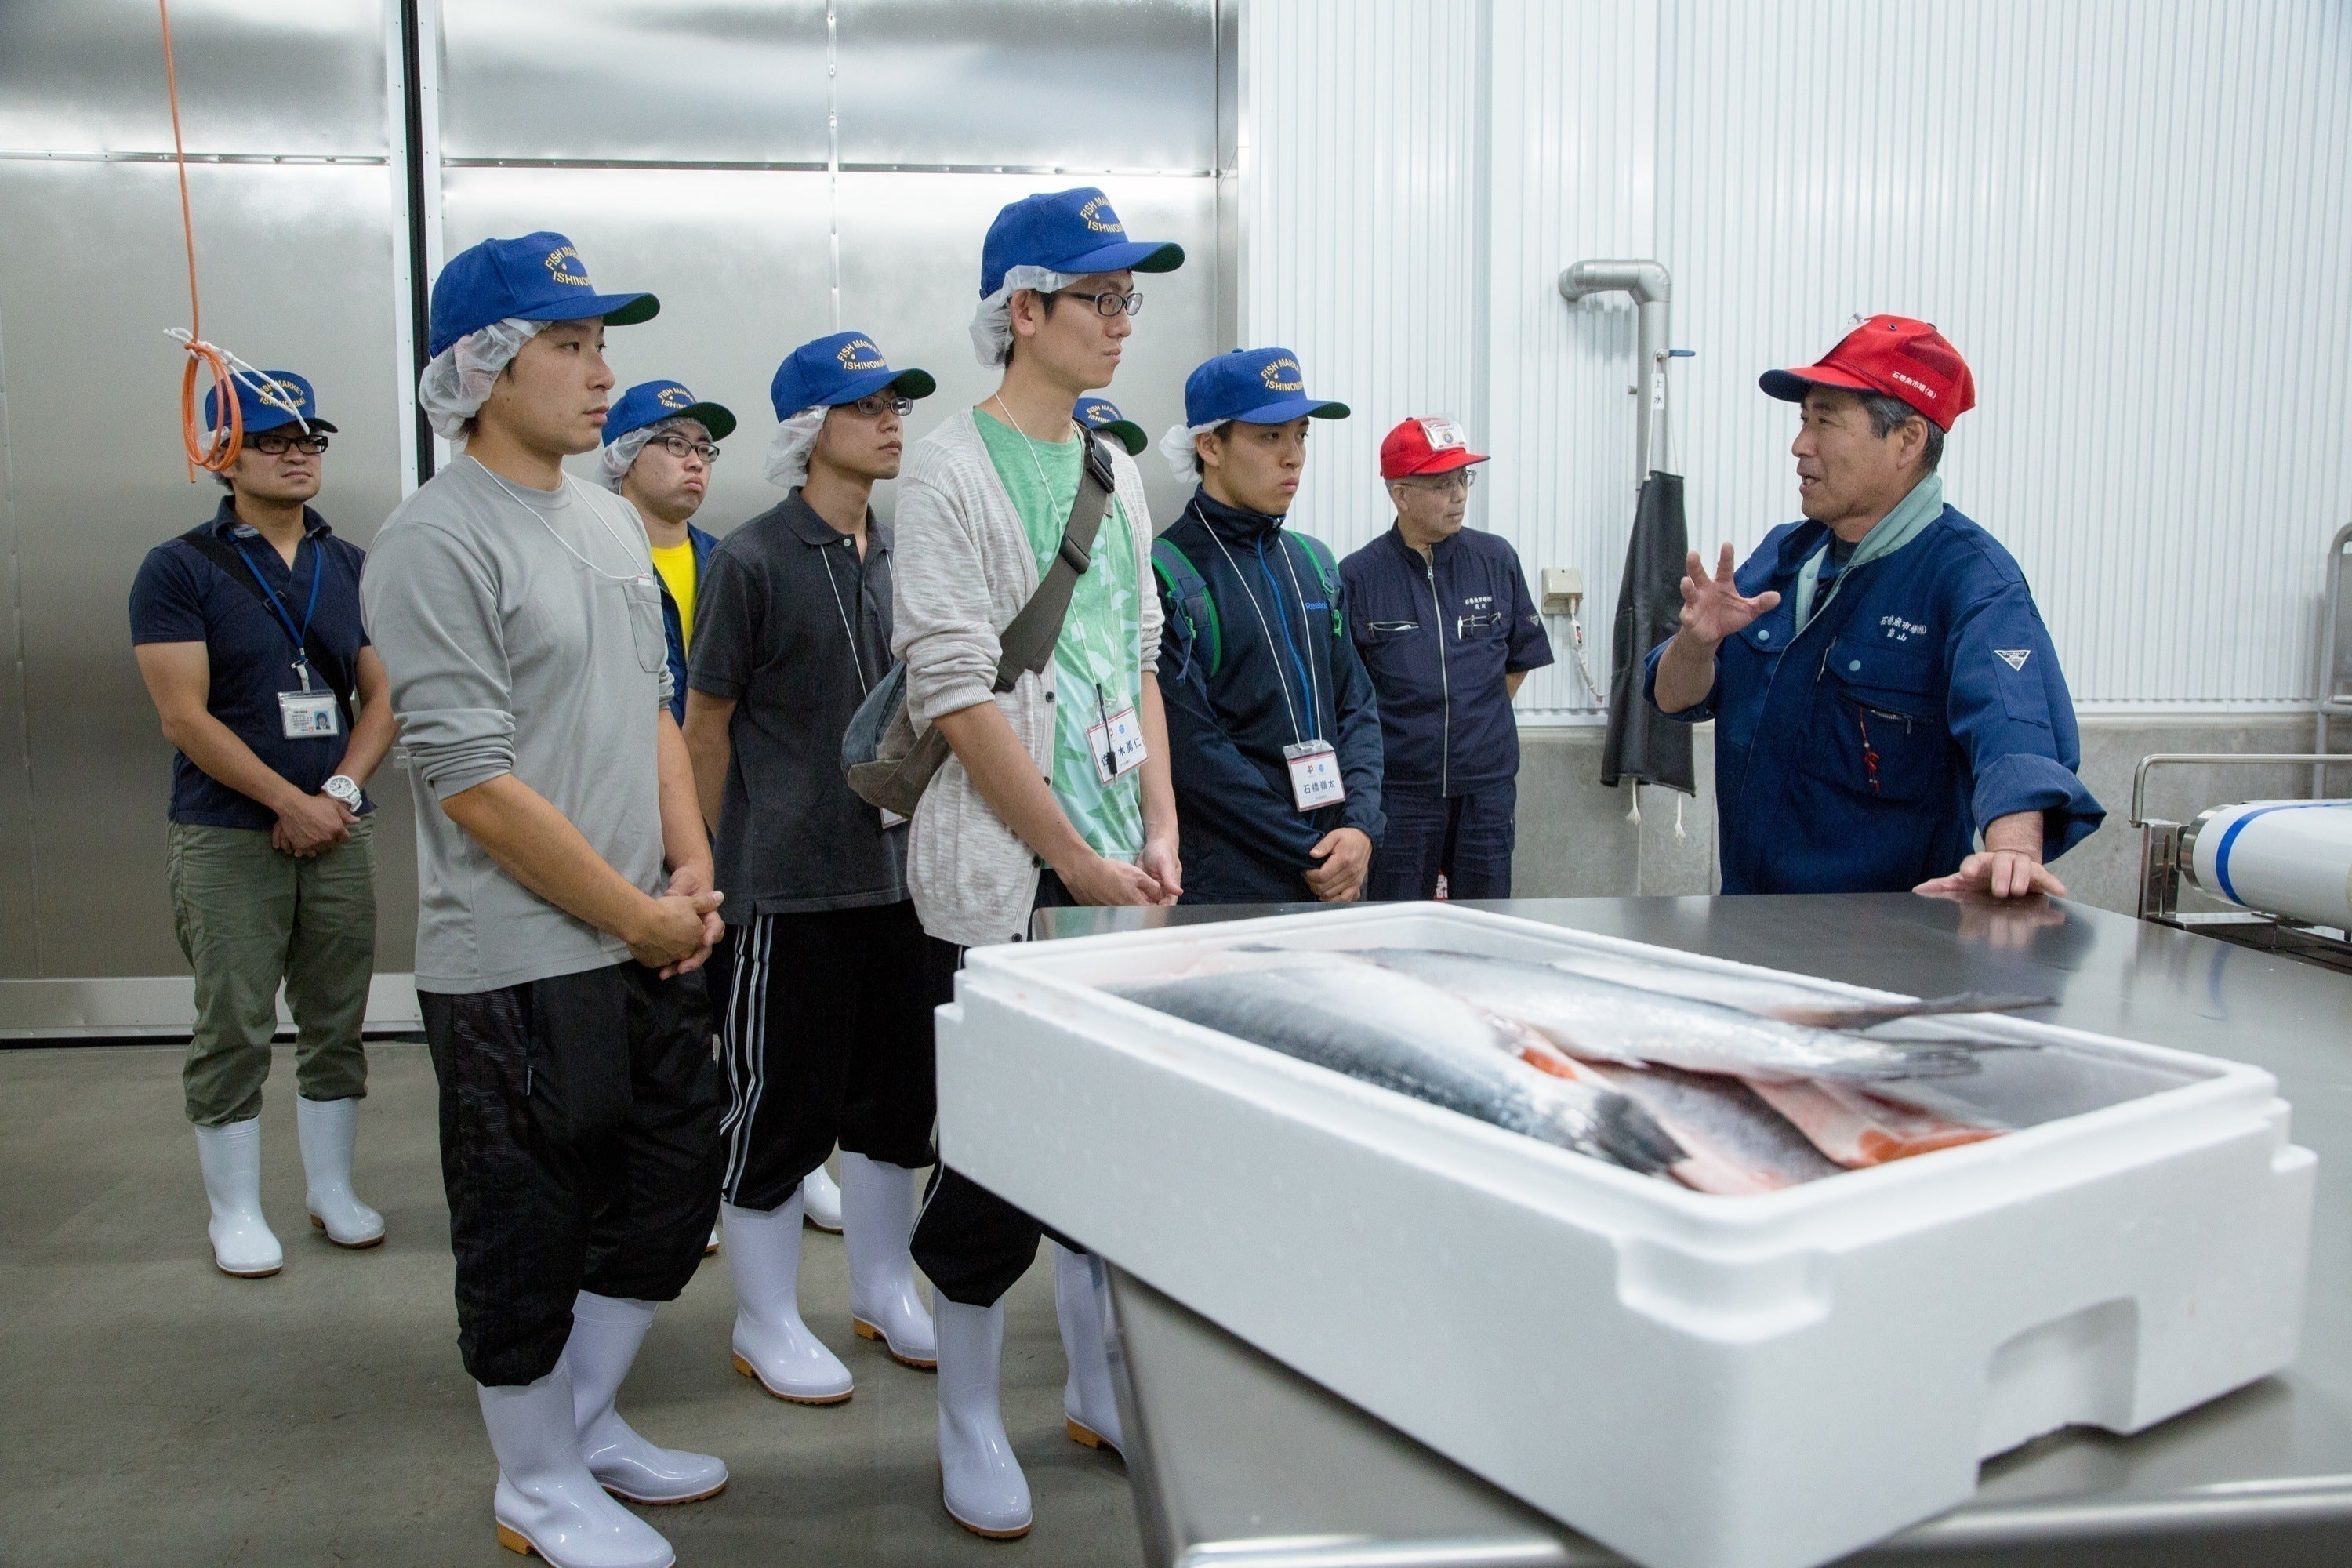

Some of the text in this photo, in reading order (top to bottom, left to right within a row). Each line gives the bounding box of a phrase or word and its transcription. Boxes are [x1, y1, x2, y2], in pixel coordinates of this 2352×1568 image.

[1080, 200, 1098, 220] FISH
[545, 249, 564, 270] FISH
[837, 343, 855, 361] FISH
[1261, 361, 1279, 379] FISH
[657, 388, 674, 401] FISH
[1653, 378, 1663, 405] 上水
[1101, 737, 1142, 767] 佐木勇仁
